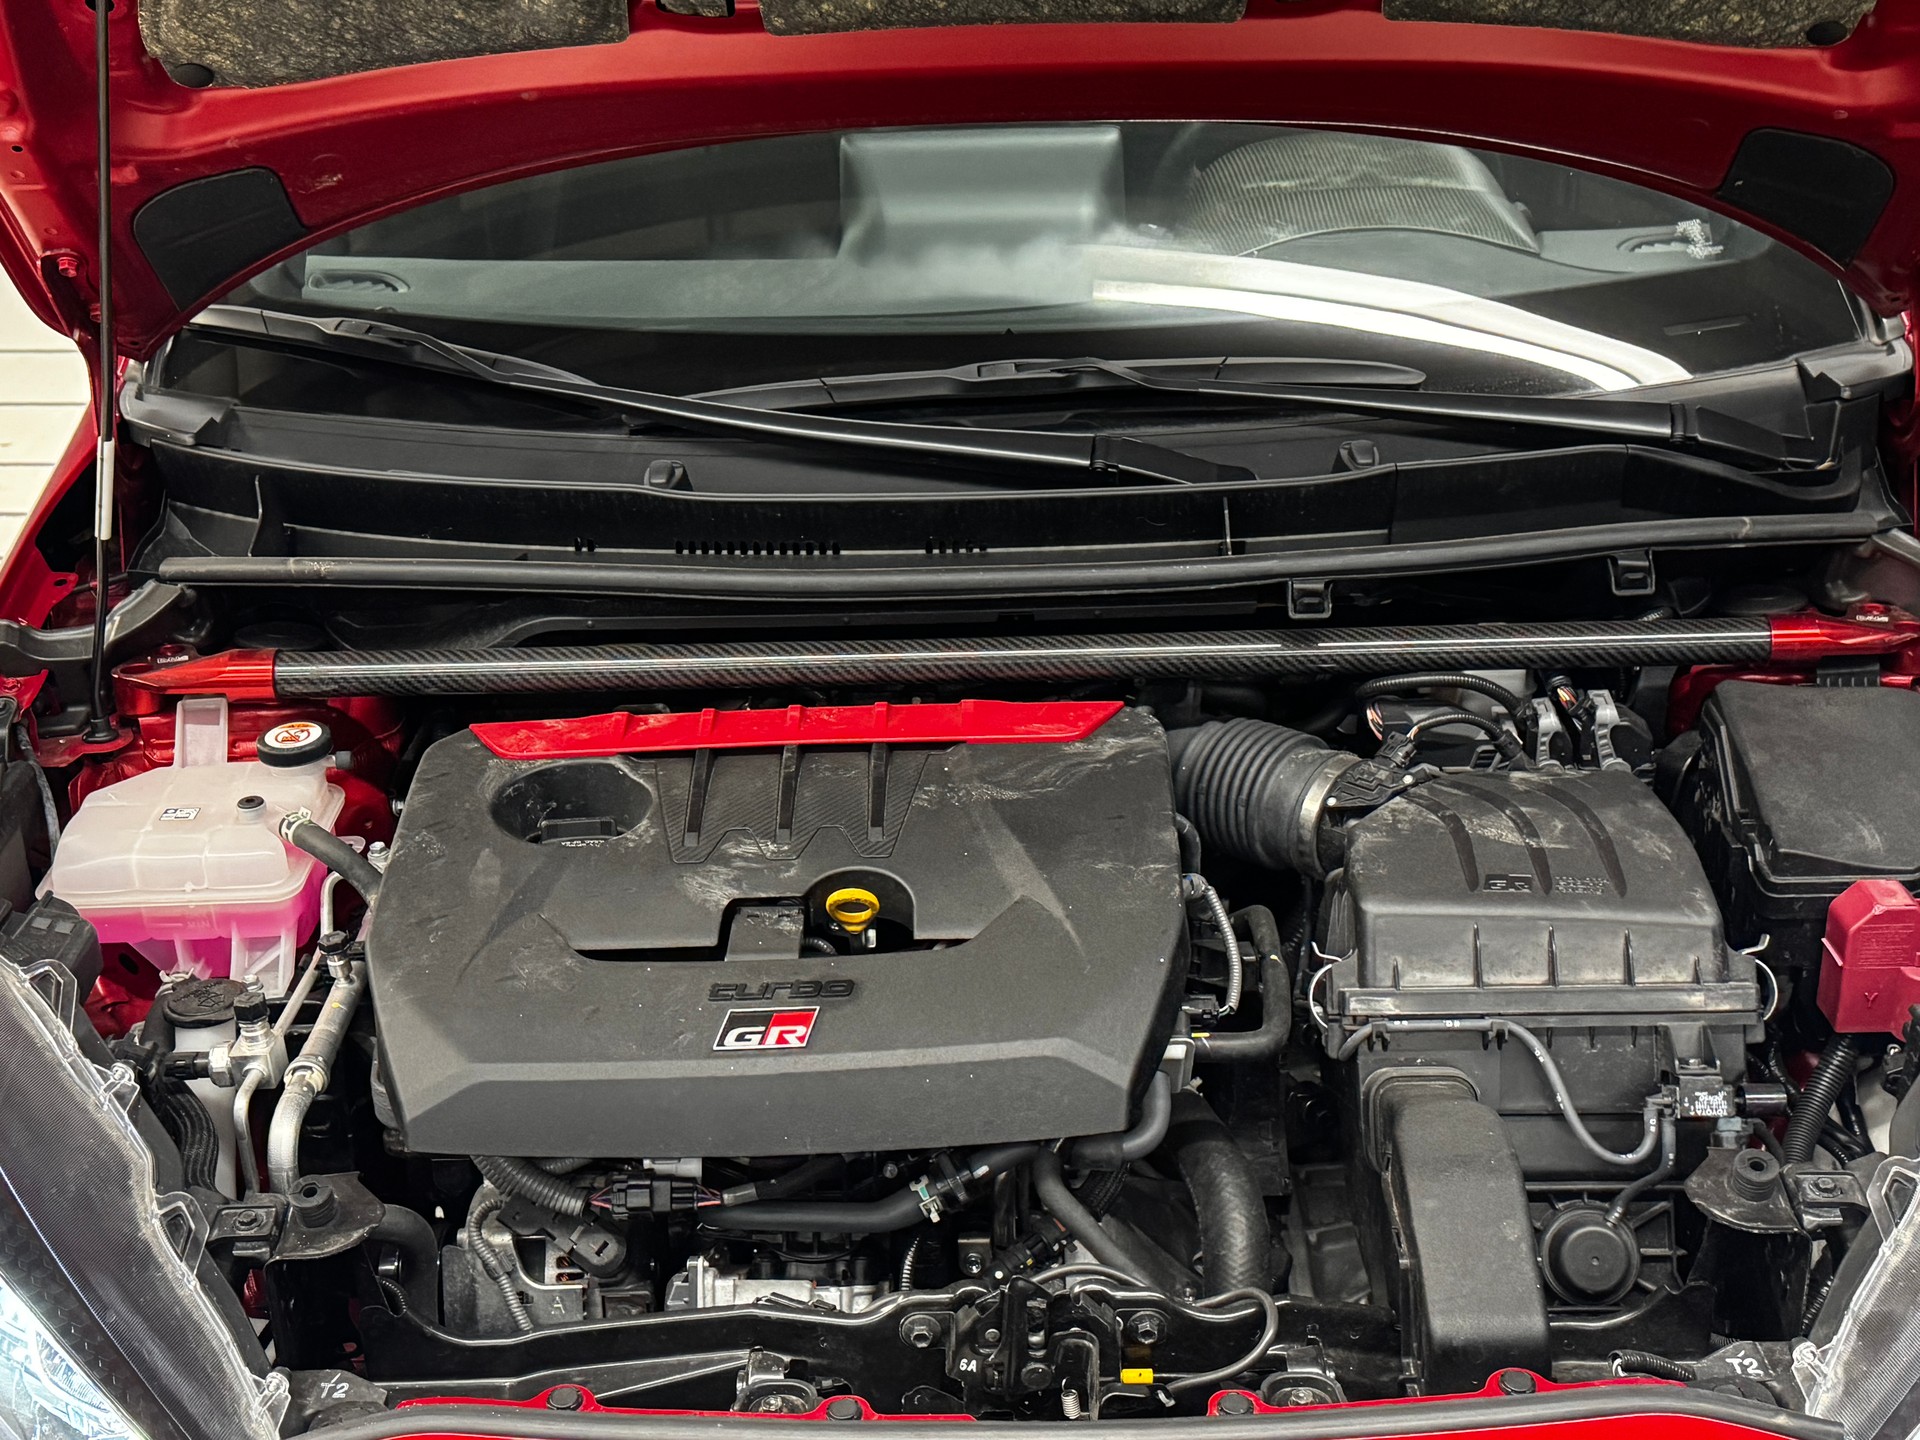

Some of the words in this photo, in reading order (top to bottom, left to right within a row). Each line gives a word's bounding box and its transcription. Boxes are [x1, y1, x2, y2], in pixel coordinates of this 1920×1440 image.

[708, 979, 855, 1002] turbo
[723, 1025, 808, 1047] GR
[1695, 1108, 1728, 1117] TOYOTA
[959, 1358, 977, 1373] 6A
